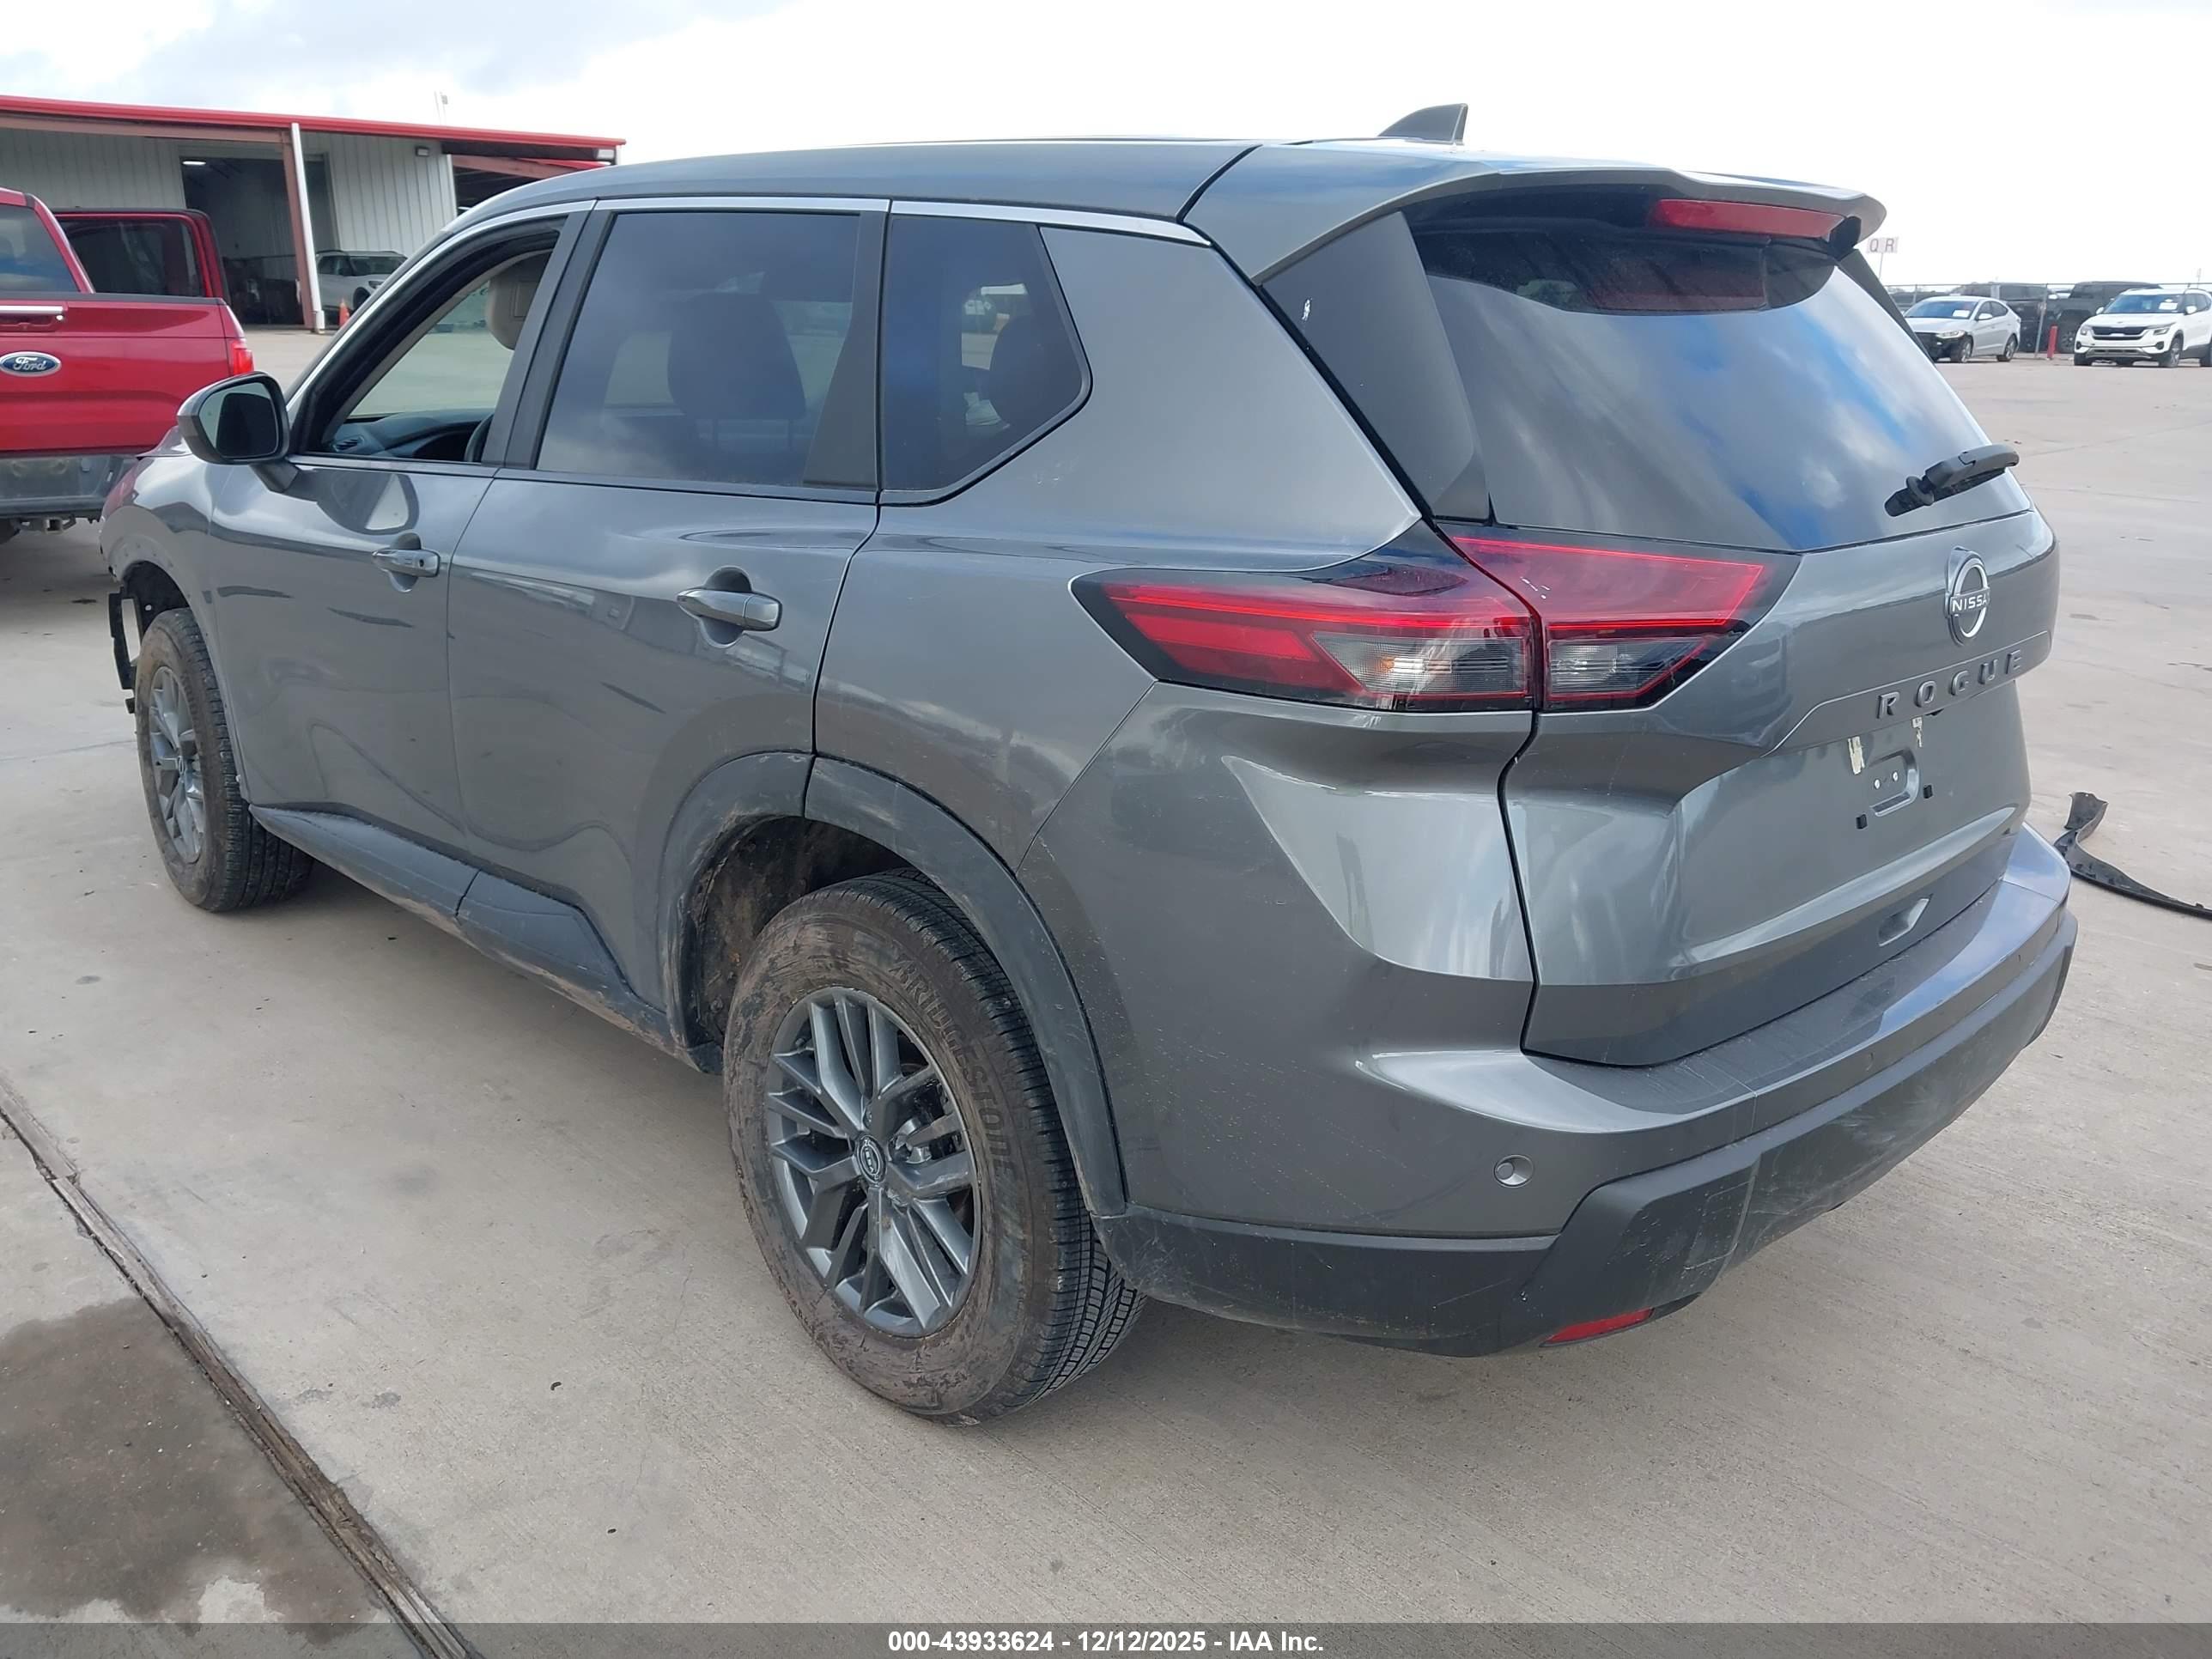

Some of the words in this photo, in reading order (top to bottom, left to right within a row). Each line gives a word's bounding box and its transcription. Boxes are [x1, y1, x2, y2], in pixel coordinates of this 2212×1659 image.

[1885, 237, 1894, 252] R
[13, 356, 47, 370] Ford
[1951, 593, 1990, 612] NISSA
[1876, 649, 2021, 719] ROGUE
